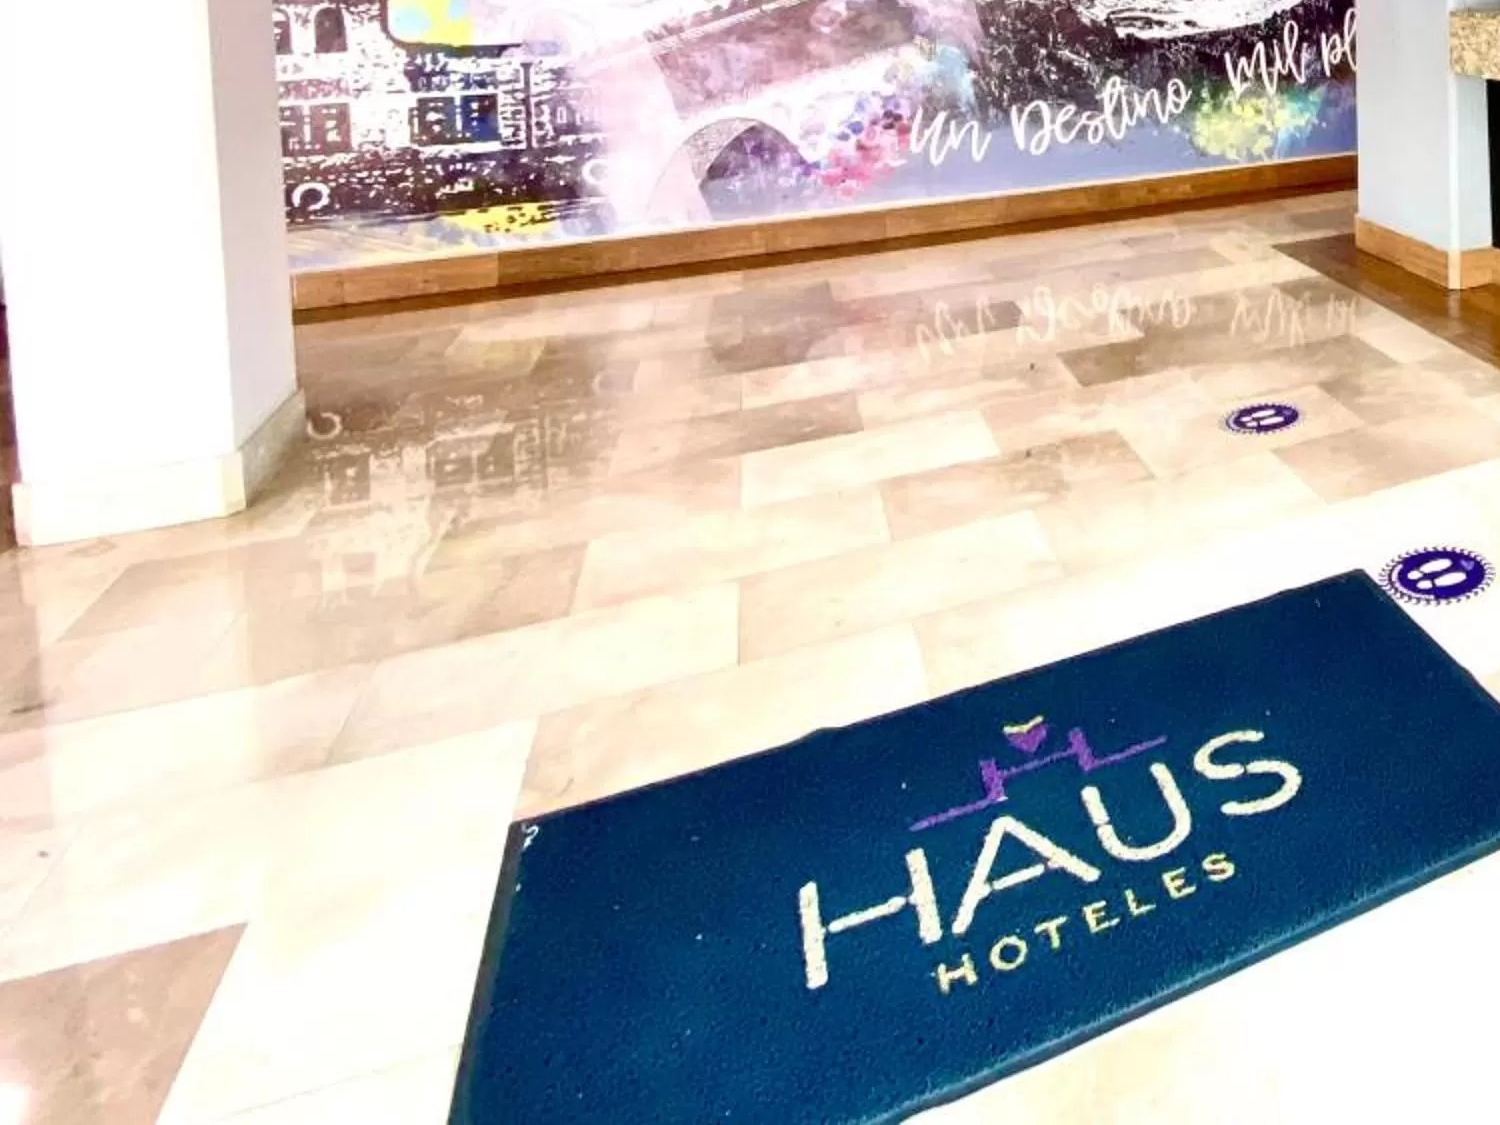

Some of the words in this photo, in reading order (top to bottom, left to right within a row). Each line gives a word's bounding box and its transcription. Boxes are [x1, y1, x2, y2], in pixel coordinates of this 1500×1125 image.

[910, 106, 992, 166] Un
[1010, 75, 1192, 156] Destino
[799, 729, 1302, 990] HAUS
[935, 852, 1237, 994] HOTELES
